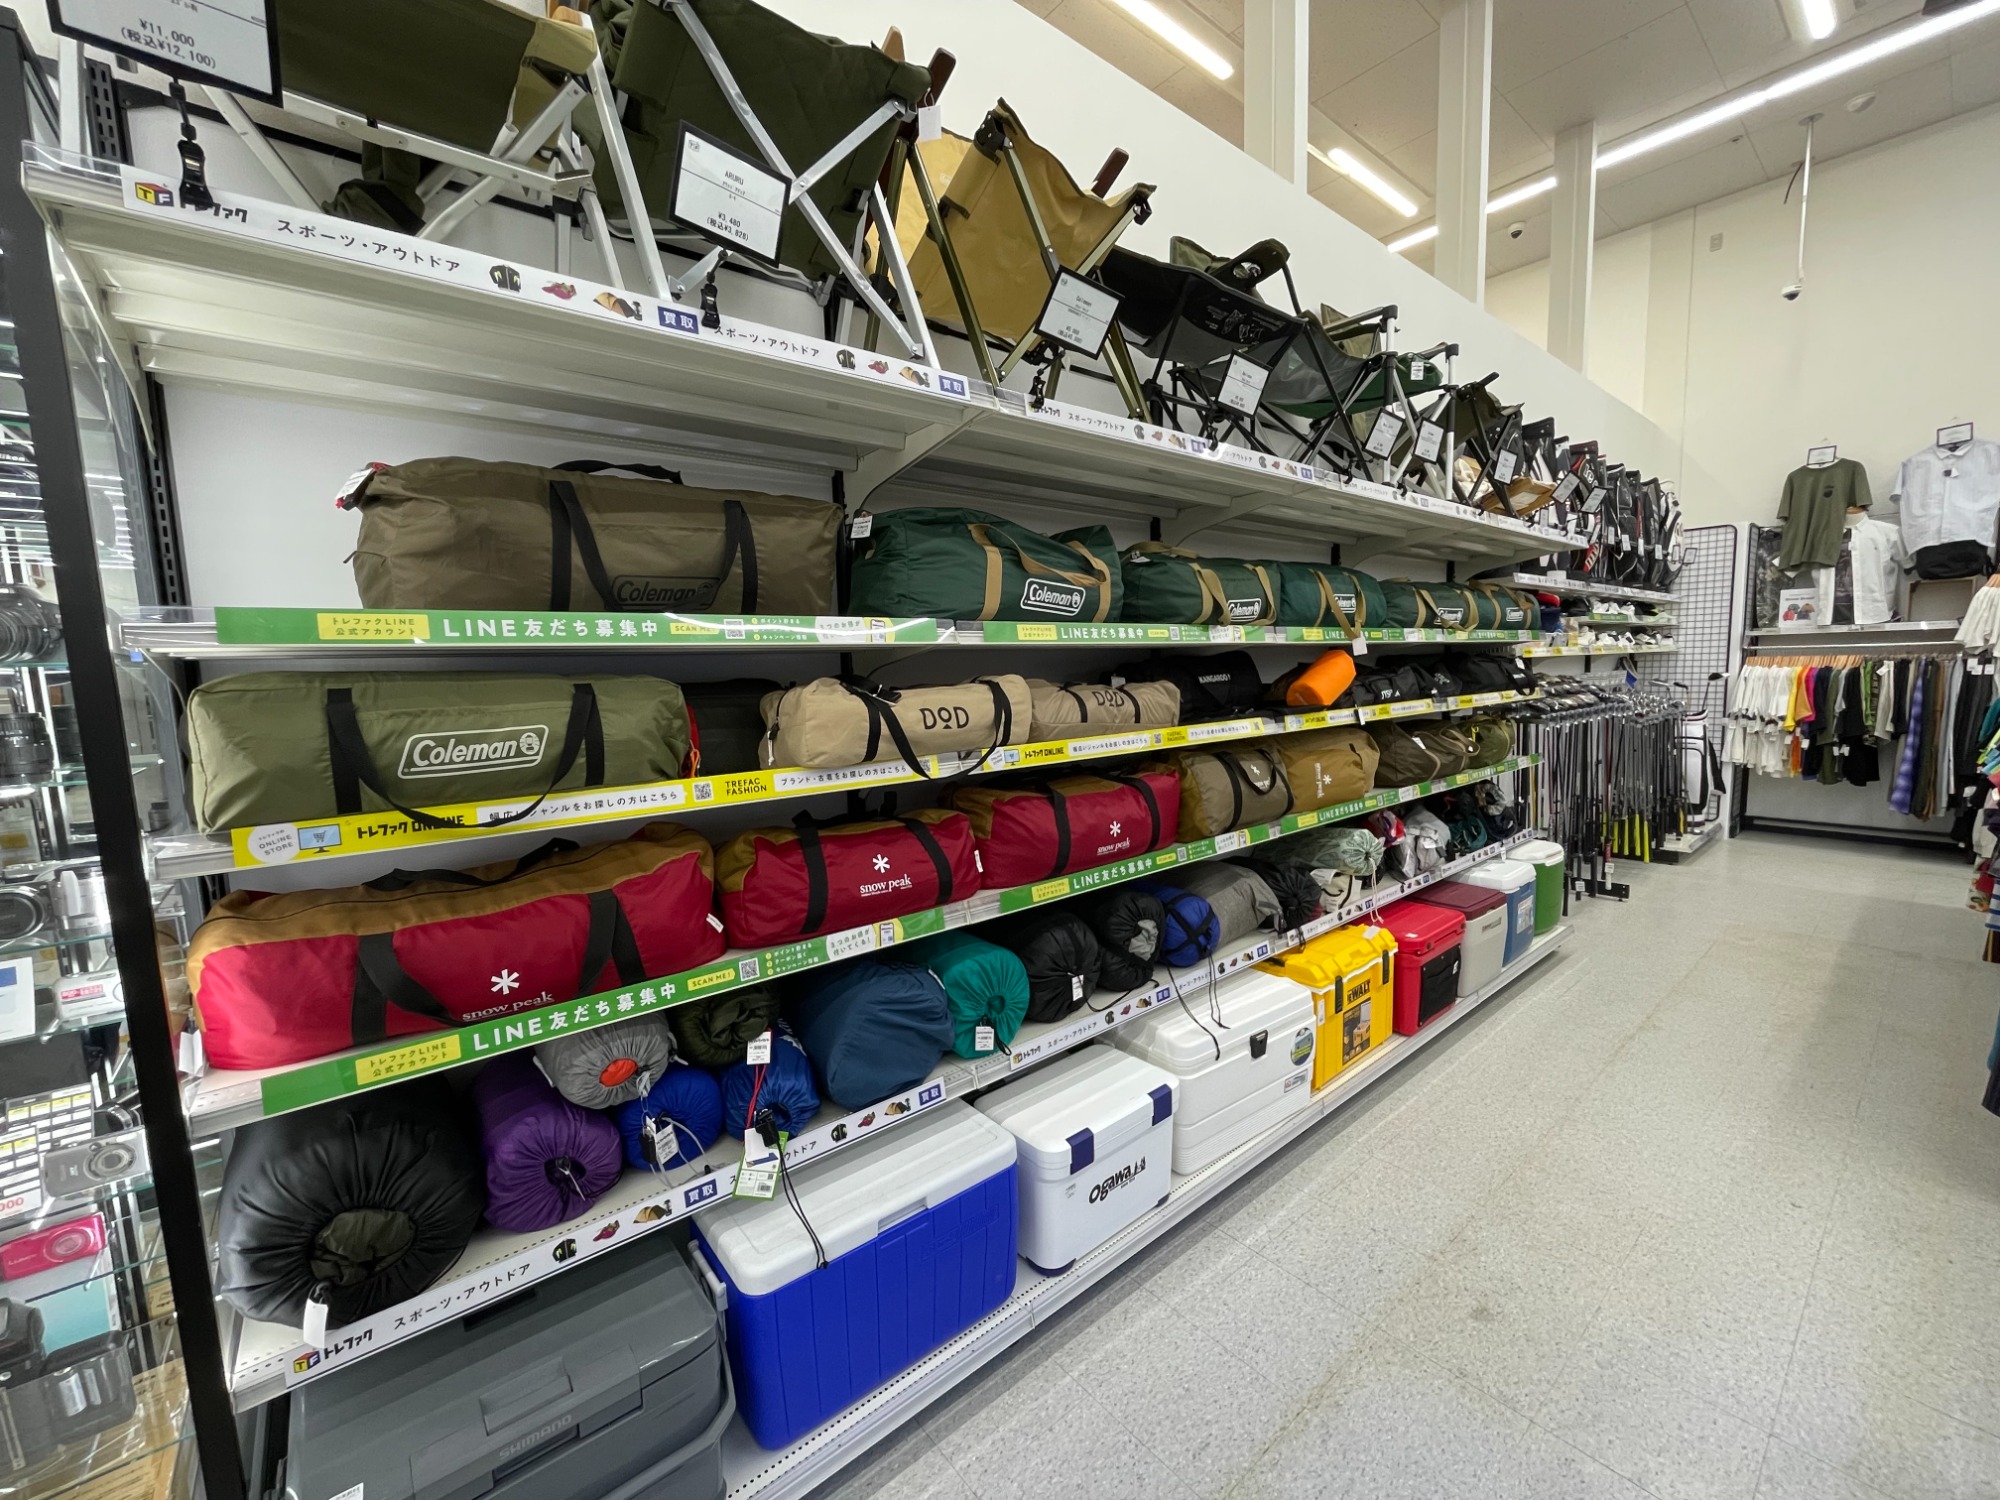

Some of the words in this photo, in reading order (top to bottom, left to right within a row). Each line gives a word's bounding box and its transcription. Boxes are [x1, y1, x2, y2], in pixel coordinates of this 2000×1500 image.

[180, 201, 248, 223] ファク
[277, 218, 461, 272] スポーツ・アウトドア
[662, 310, 694, 331] 買取
[714, 325, 820, 358] スポーツ・アウトドア
[942, 378, 964, 393] 買取
[617, 580, 698, 602] Coleman
[1028, 584, 1073, 606] Coleman
[1229, 602, 1254, 617] Coleman
[332, 617, 415, 626] トレファクLINE
[335, 627, 416, 636] 公式アカウント
[675, 624, 697, 633] SCAN
[412, 738, 518, 768] Coleman
[725, 777, 761, 789] TREFAC
[726, 784, 767, 797] FASHION
[489, 790, 678, 821] 幅広ャンルをお探しの方はこちら
[357, 822, 408, 839] トレファク
[259, 834, 292, 850] ONLINE
[264, 841, 294, 856] STORE
[1097, 844, 1113, 854] snow
[1113, 838, 1130, 852] peak
[859, 880, 887, 894] snow
[889, 873, 912, 893] peak
[692, 976, 714, 988] SCAN
[715, 972, 732, 982] ME!
[461, 1003, 510, 1022] snow
[512, 991, 554, 1012] peak
[370, 1042, 447, 1068] トレファクLINE
[373, 1051, 447, 1077] 公式アカウント
[688, 1184, 714, 1204] 買取
[323, 1328, 374, 1360] トレファク
[393, 1262, 532, 1331] スポーツ・アウトドア
[499, 1414, 573, 1460] SHIMANO
